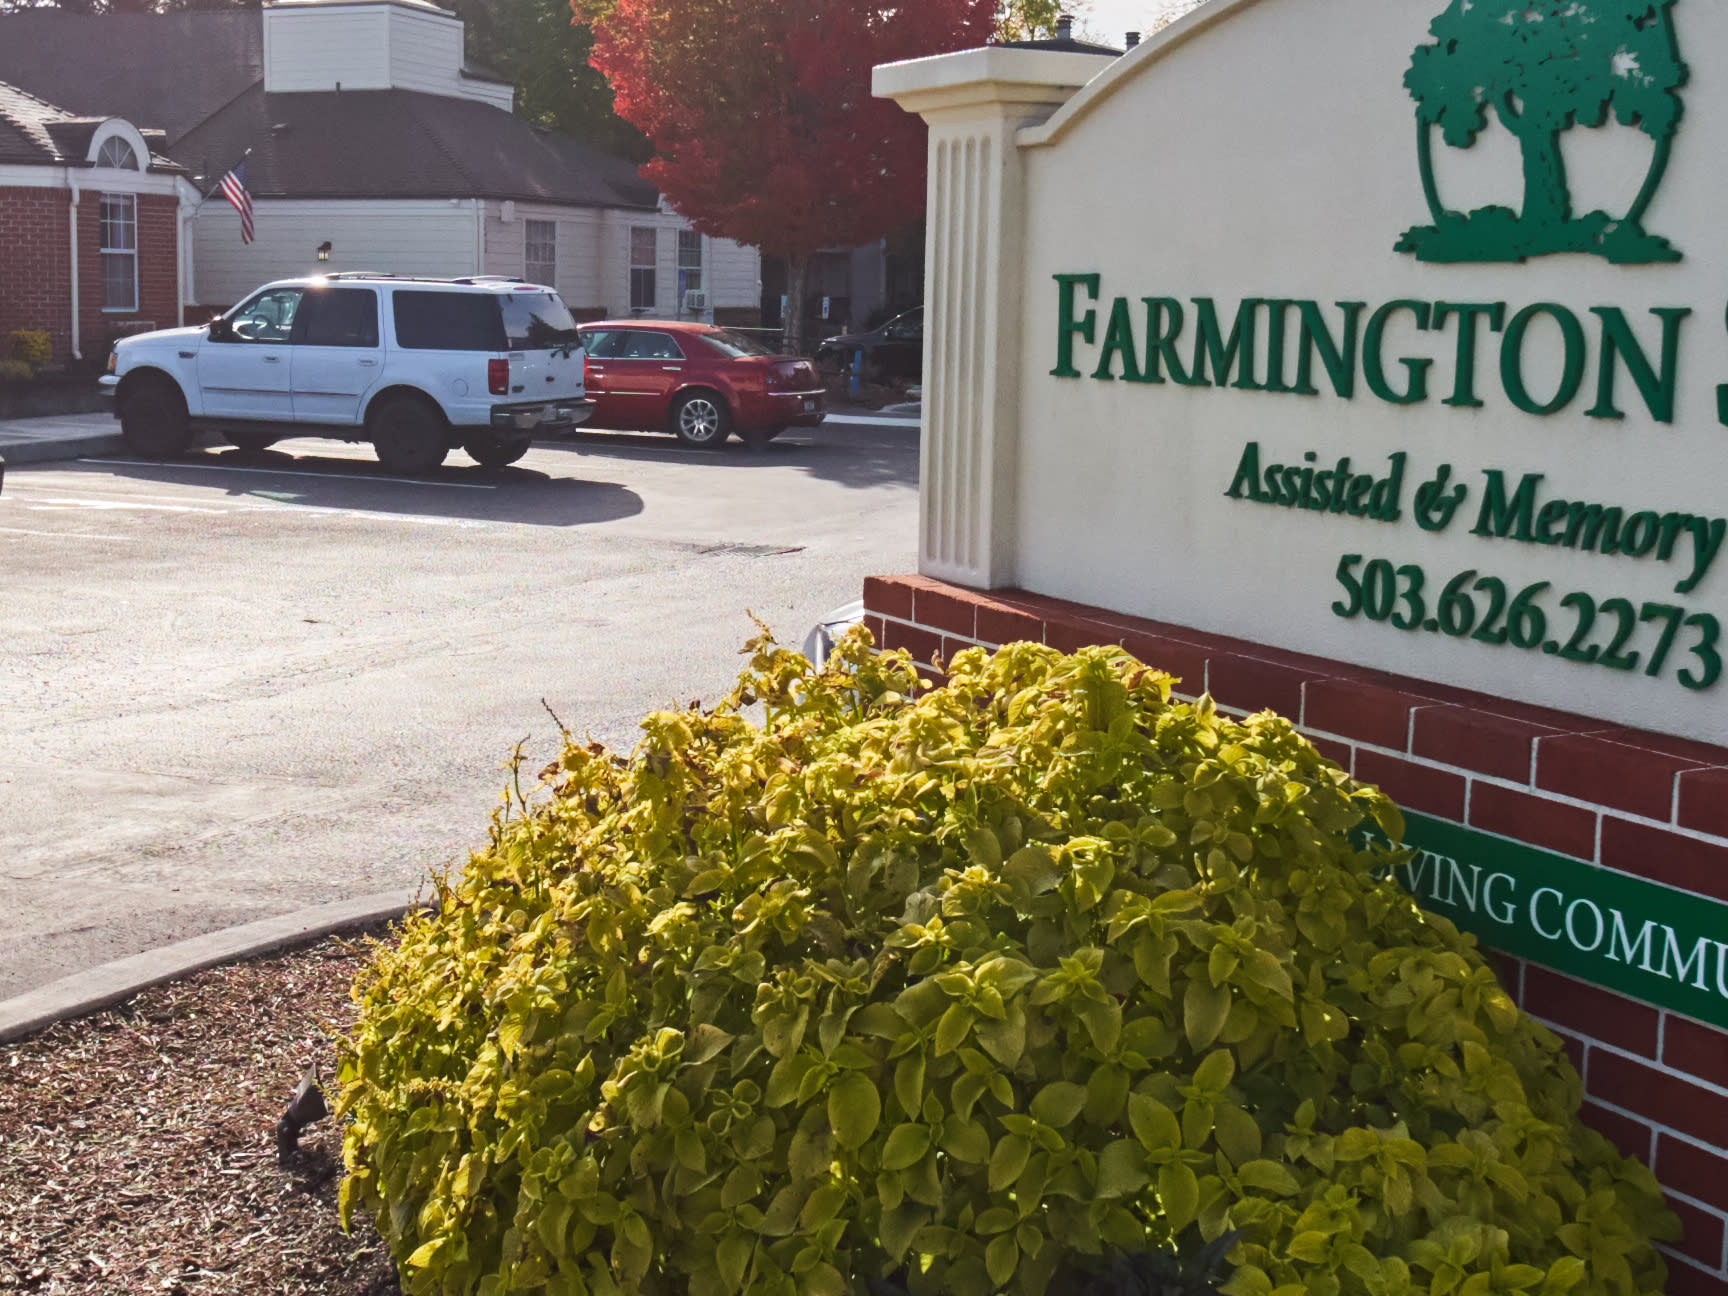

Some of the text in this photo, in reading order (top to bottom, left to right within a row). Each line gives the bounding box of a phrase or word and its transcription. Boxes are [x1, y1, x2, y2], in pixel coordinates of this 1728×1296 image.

[1051, 272, 1691, 424] FARMINGTON
[1224, 442, 1406, 522] Assisted
[1414, 464, 1467, 532] &
[1469, 468, 1727, 594] Memory
[1332, 554, 1723, 691] 503.626.2273
